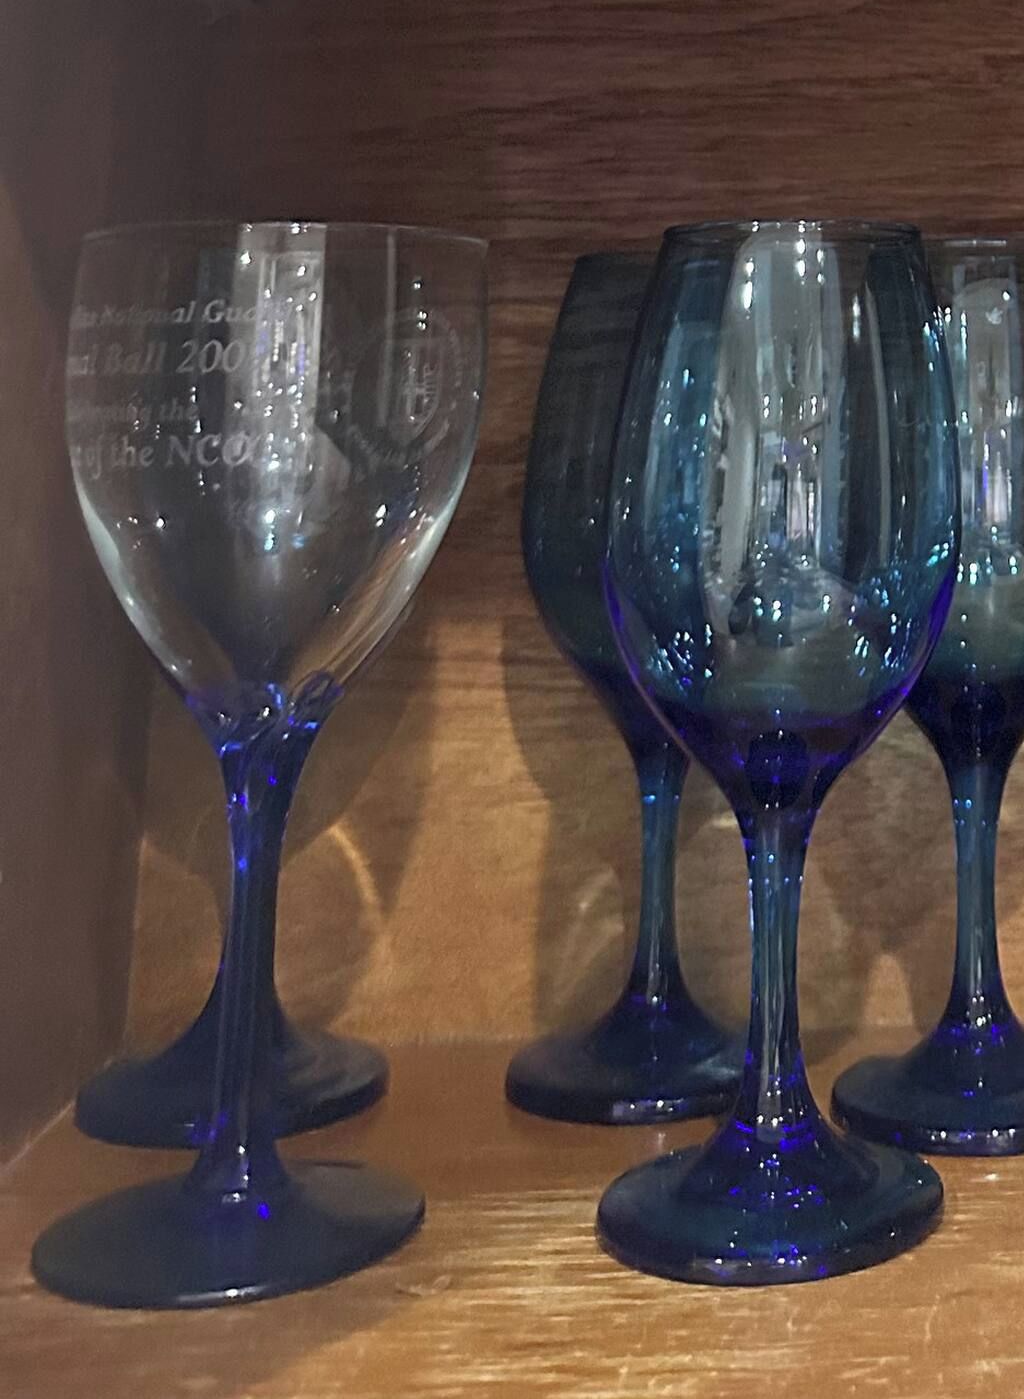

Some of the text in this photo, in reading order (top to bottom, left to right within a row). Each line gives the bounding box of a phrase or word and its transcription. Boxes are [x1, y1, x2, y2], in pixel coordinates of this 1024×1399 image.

[103, 342, 167, 375] Ball
[176, 338, 258, 375] 200
[110, 434, 155, 468] the
